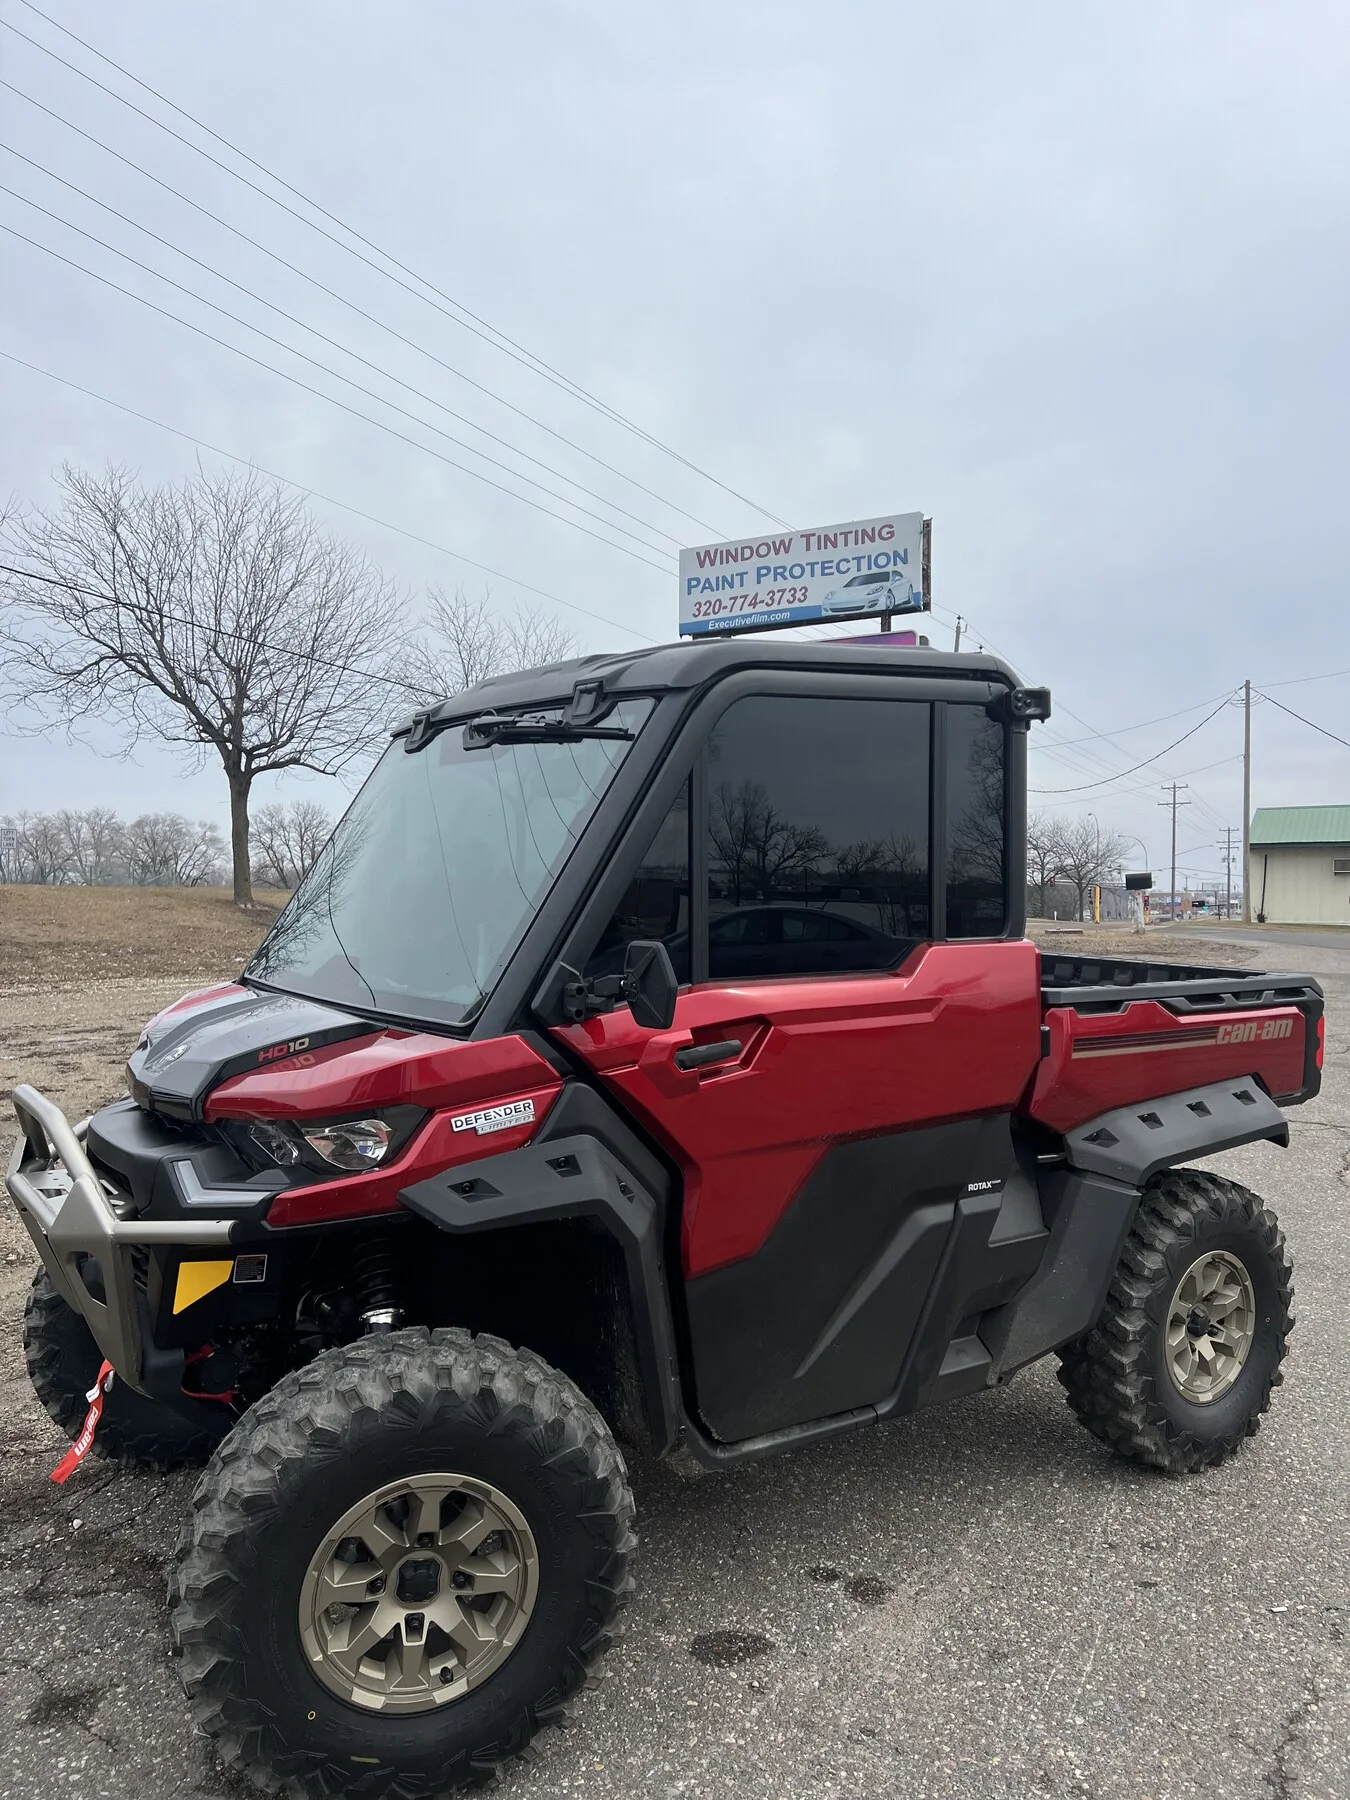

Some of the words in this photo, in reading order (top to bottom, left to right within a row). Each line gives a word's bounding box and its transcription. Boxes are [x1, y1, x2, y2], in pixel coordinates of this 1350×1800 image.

[695, 537, 793, 569] WINDOW
[800, 523, 895, 552] TINTING
[686, 571, 748, 596] PAINT
[756, 548, 909, 584] PROTECTION
[692, 586, 808, 618] 320-774-3733
[708, 611, 790, 631] Executivefilm.com
[258, 1037, 310, 1062] HD10
[453, 1102, 532, 1128] DEFENDER
[479, 1115, 531, 1132] LIMITED
[967, 1180, 992, 1191] ROTAX
